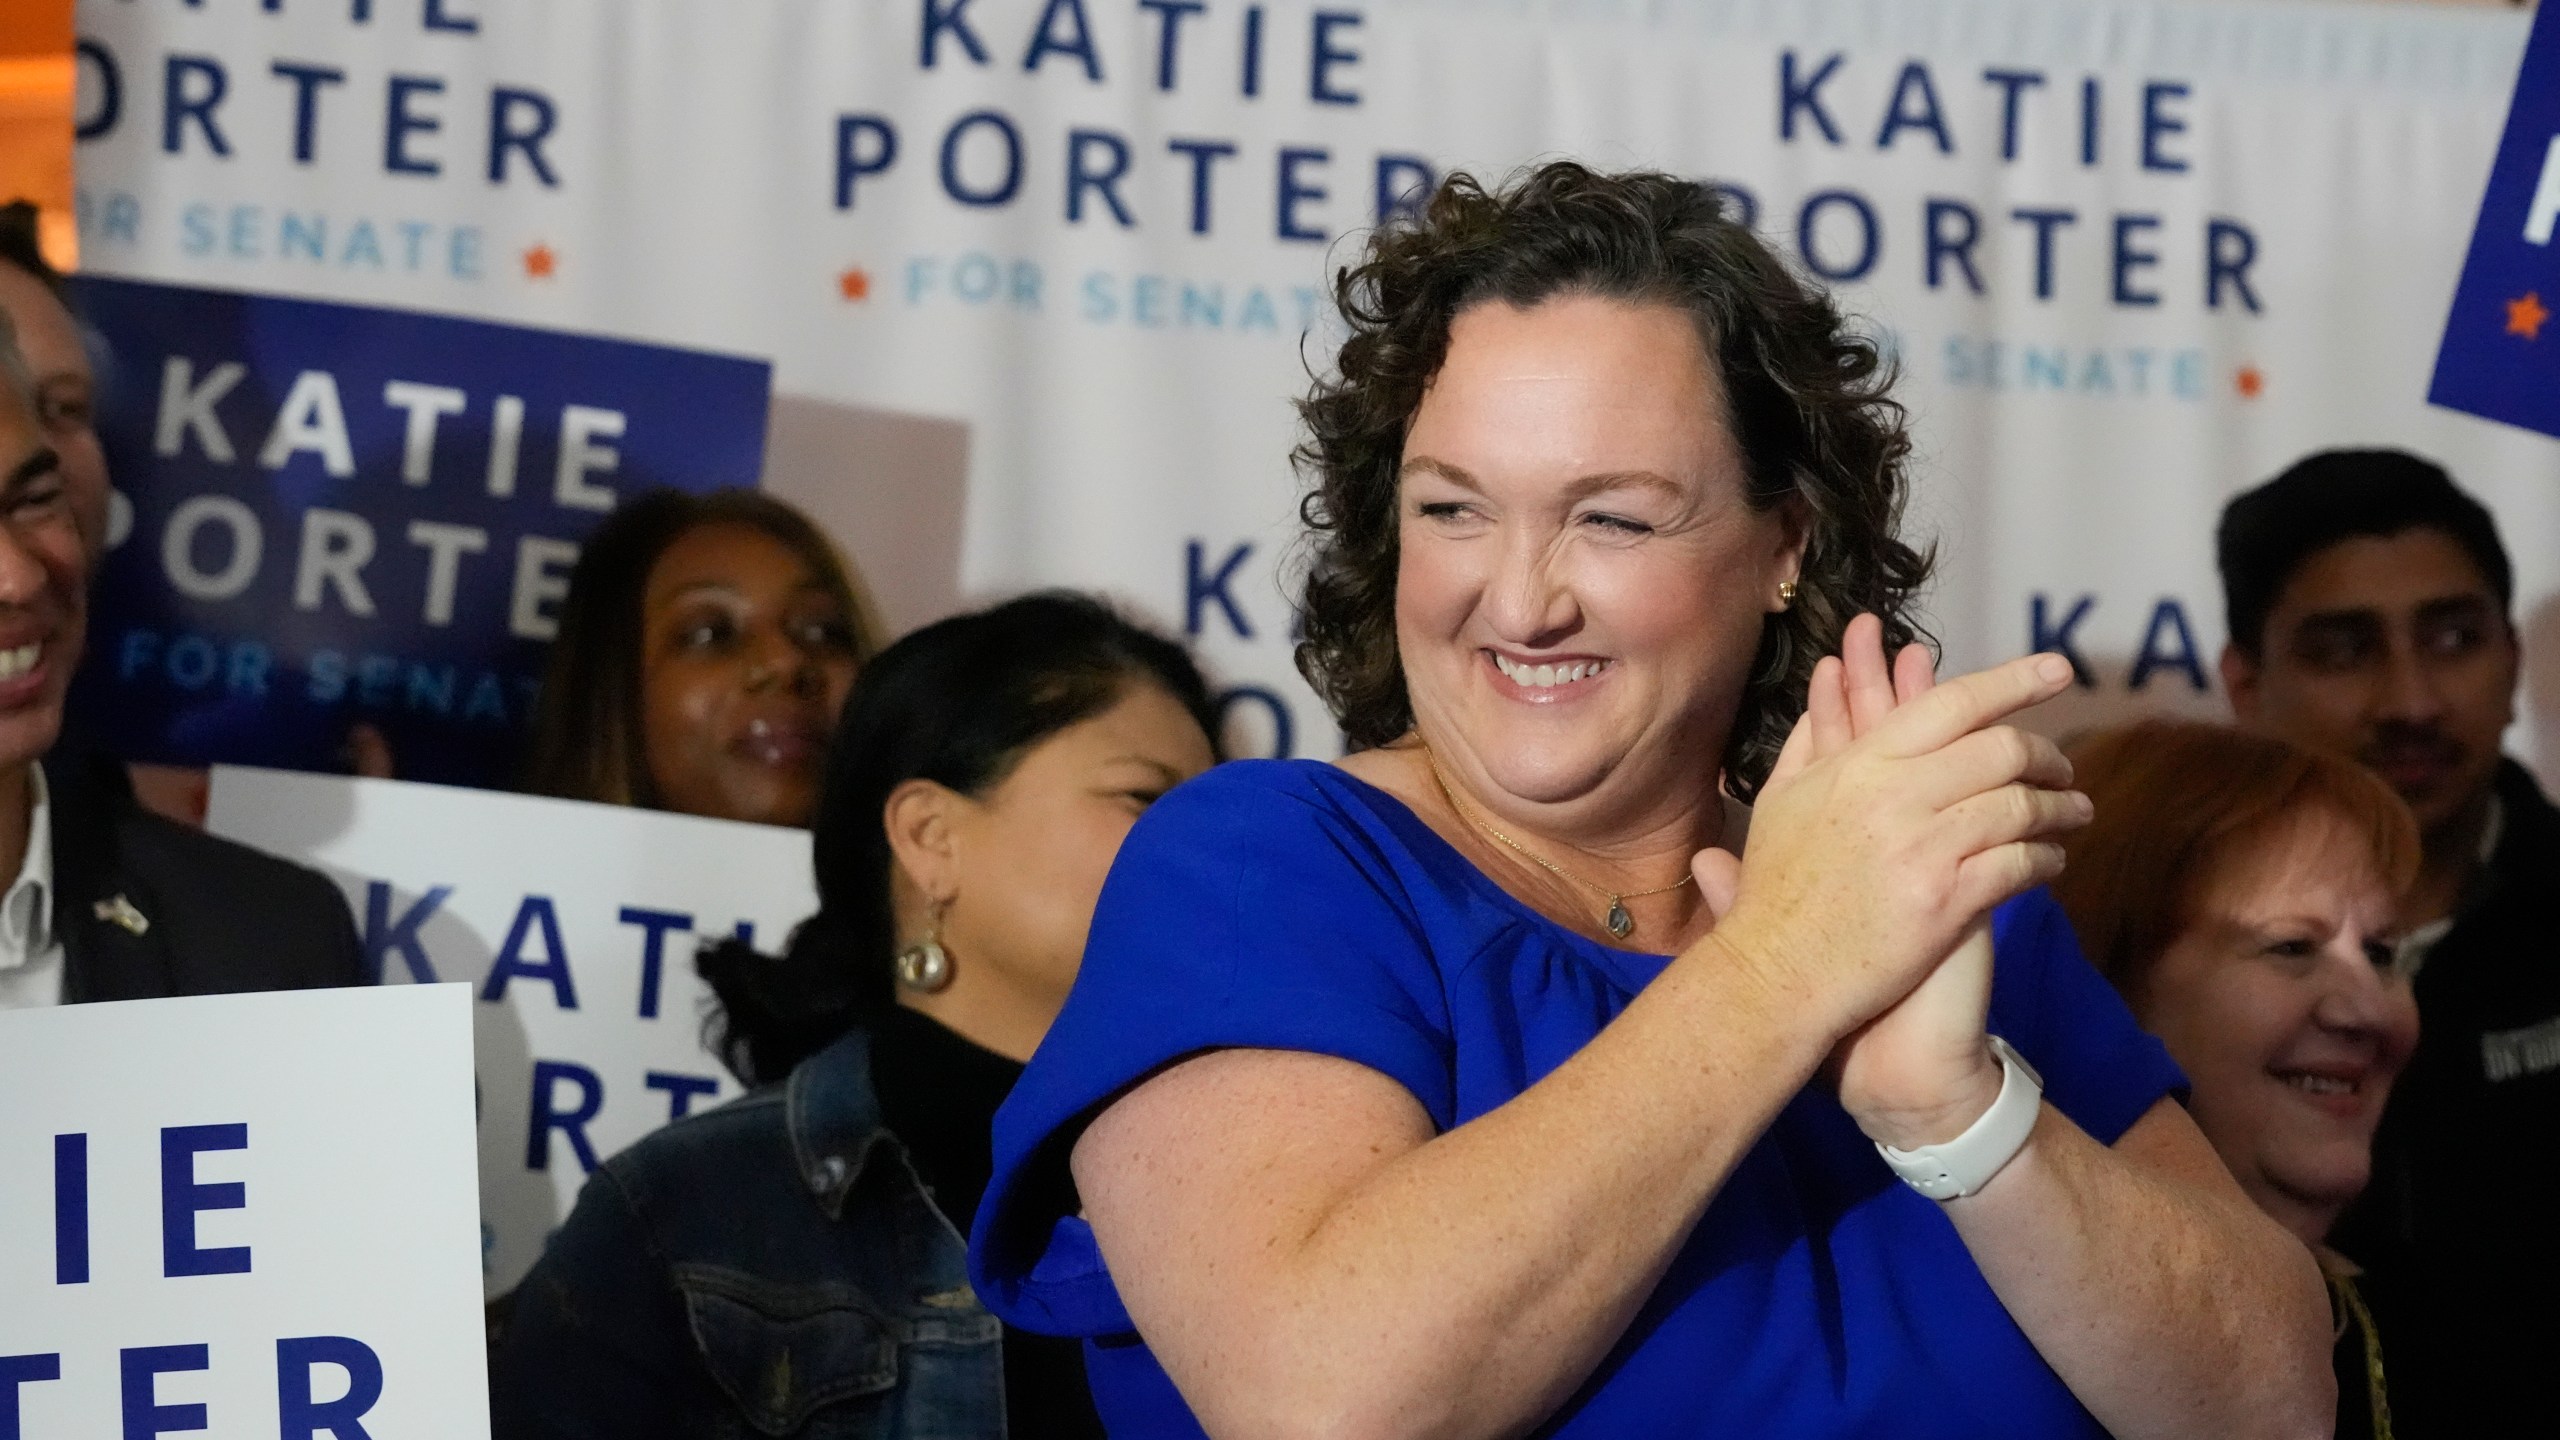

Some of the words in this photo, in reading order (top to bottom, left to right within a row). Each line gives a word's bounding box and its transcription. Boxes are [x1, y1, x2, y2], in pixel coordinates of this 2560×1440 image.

[918, 0, 1364, 104] KATIE
[1778, 48, 2192, 172] KATIE
[834, 110, 1438, 244] PORTER
[182, 202, 484, 279] SENATE
[905, 252, 1043, 312] FOR
[1083, 272, 1345, 338] SENAT
[1942, 334, 2208, 398] SENATE
[153, 356, 627, 511] KATIE
[118, 628, 275, 696] FOR
[364, 880, 755, 1019] KAT
[55, 1123, 252, 1285] IE
